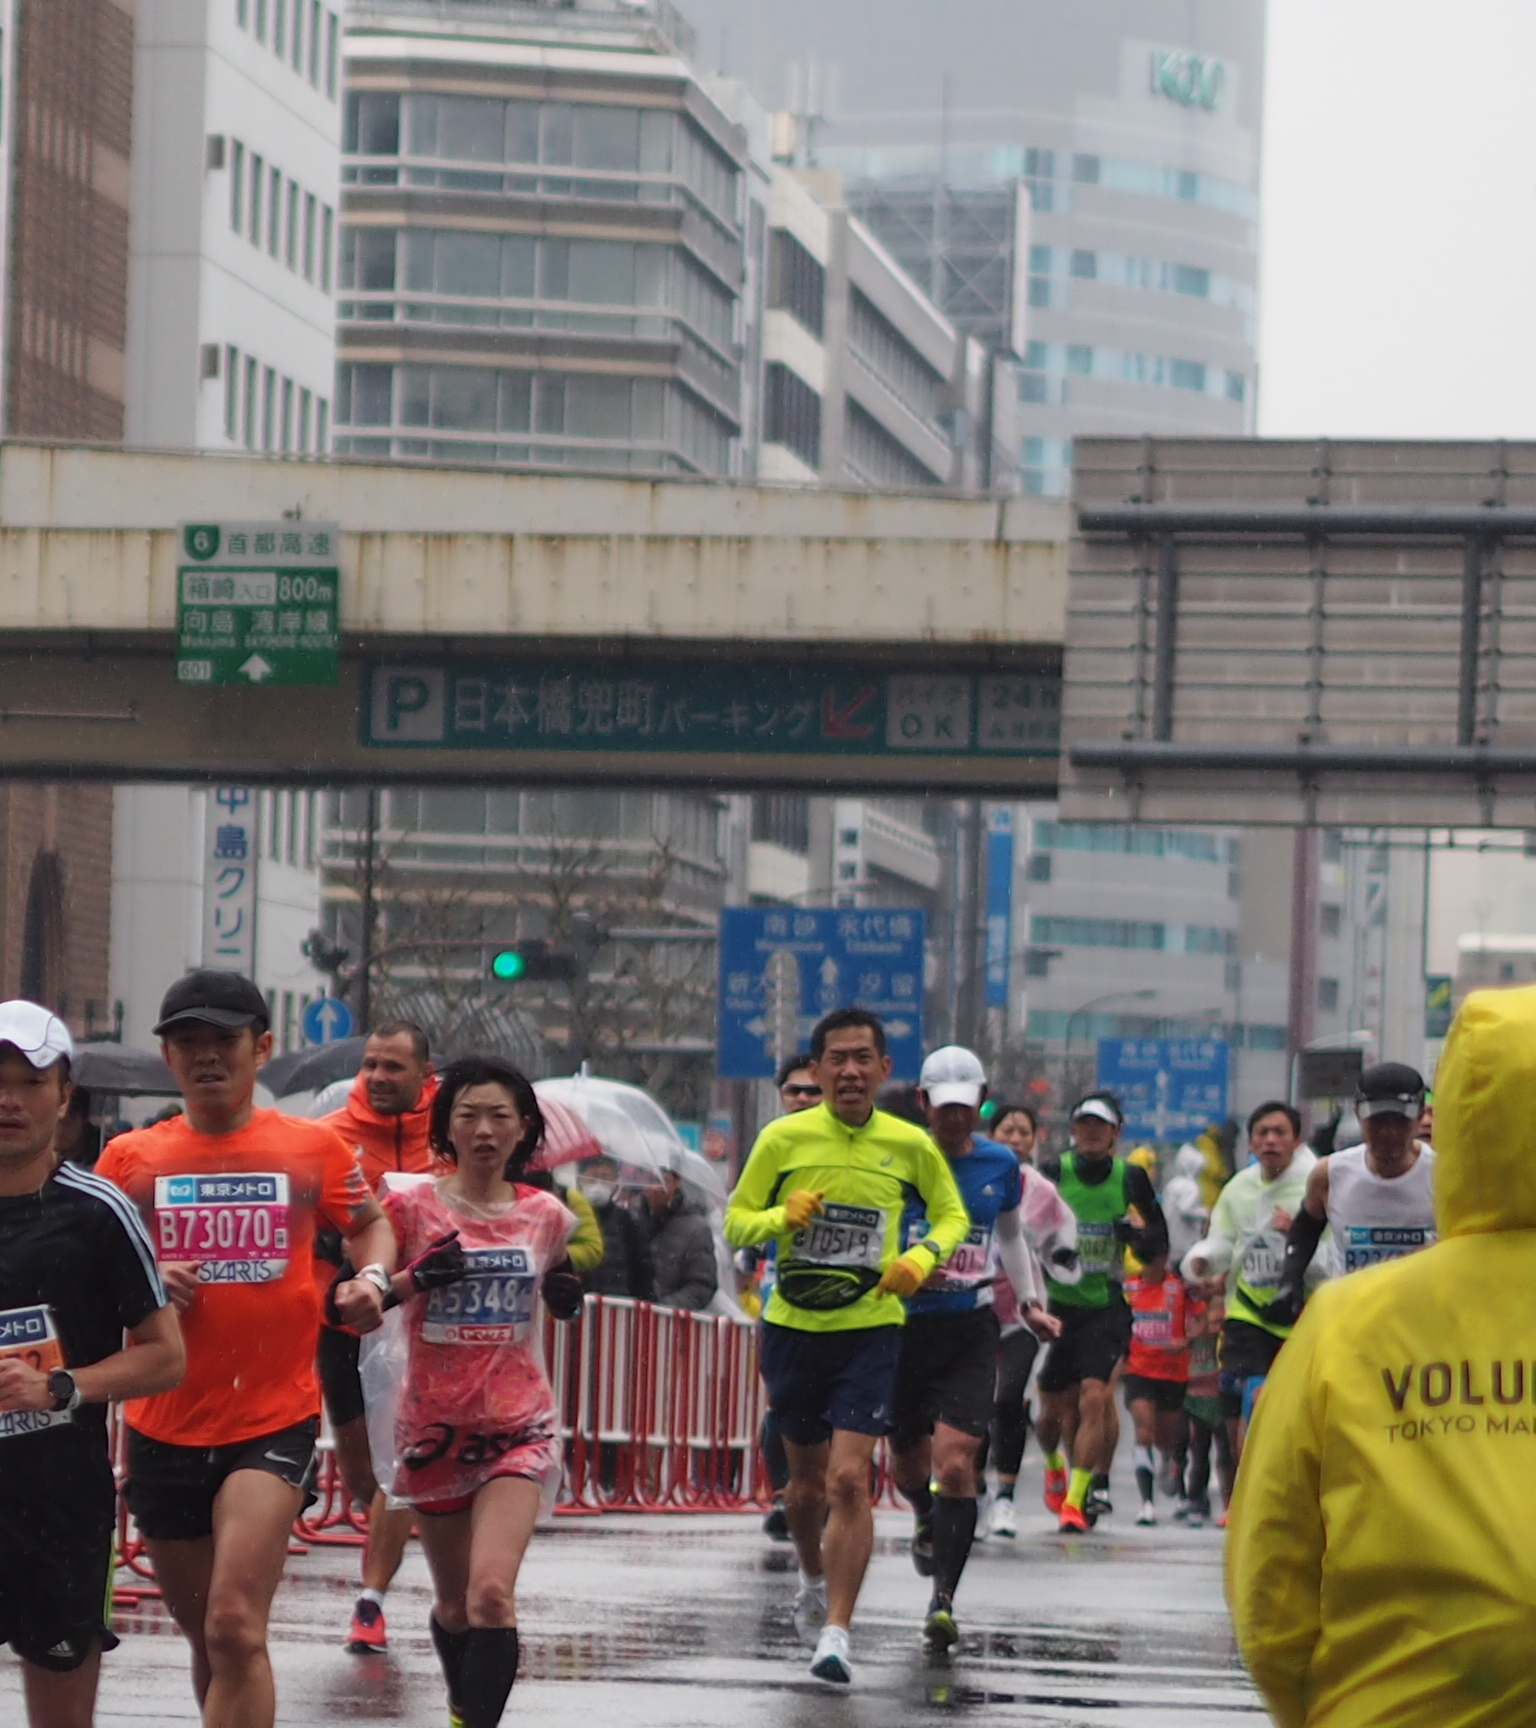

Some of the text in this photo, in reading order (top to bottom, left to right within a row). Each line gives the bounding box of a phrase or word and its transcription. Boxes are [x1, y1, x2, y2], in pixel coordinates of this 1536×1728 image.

[194, 530, 210, 552] 6
[229, 533, 330, 555] 首都高速
[279, 575, 333, 602] 800m
[184, 610, 328, 634] 向島 湾岸線
[180, 663, 210, 679] 601
[387, 677, 429, 732] P
[901, 712, 953, 739] OK
[199, 1182, 272, 1197] 東京メトロ
[158, 1208, 271, 1250] B73070
[1382, 1359, 1536, 1412] VOLU
[1384, 1415, 1475, 1443] TOKYO
